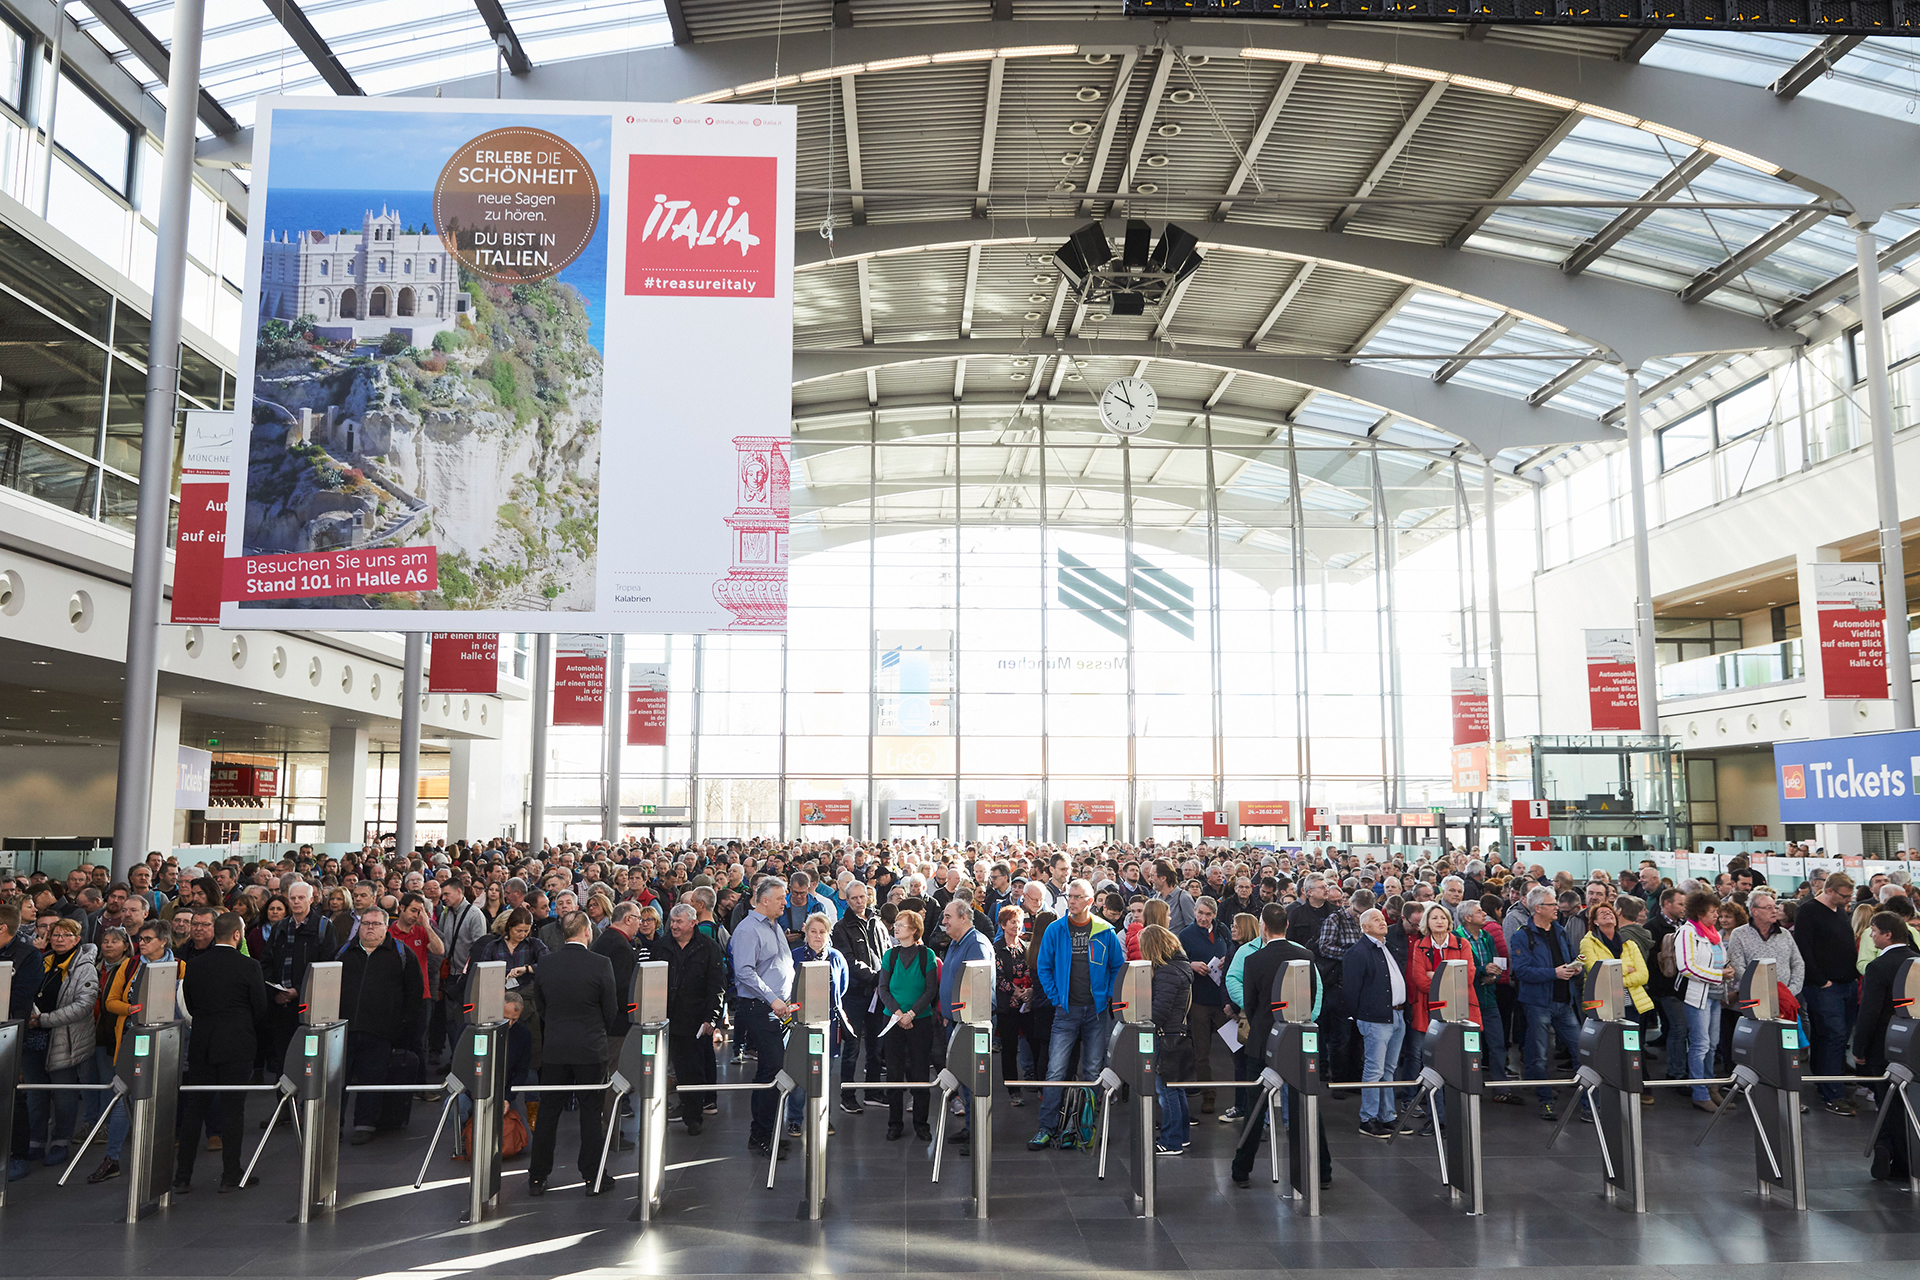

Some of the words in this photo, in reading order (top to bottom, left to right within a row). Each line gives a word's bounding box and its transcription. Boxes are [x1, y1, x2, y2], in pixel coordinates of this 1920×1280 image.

[476, 150, 532, 164] ERLEBE
[537, 152, 562, 166] DIE
[458, 165, 578, 186] SCHÖNHEIT
[478, 194, 511, 206] neue
[515, 192, 556, 209] Sagen
[484, 210, 501, 222] zu
[504, 207, 547, 222] hören.
[474, 232, 498, 246] DU
[502, 232, 536, 246] BIST
[540, 233, 556, 247] IN
[475, 250, 553, 267] ITALIEN.
[644, 276, 757, 293] #treasureitaly
[182, 530, 204, 542] auf
[247, 558, 330, 574] Besuchen
[336, 554, 360, 569] Sie
[366, 555, 396, 565] uns
[401, 552, 428, 564] am
[246, 577, 296, 593] Stand
[300, 574, 331, 590] 101
[336, 574, 351, 588] in
[356, 572, 400, 586] Halle
[404, 569, 428, 584] A6
[615, 584, 641, 592] Tropea
[1833, 620, 1880, 628] Automobile
[1851, 630, 1881, 638] Vielfalt
[471, 642, 480, 650] in
[482, 642, 496, 650] der
[1822, 640, 1835, 648] auf
[1837, 640, 1860, 648] einen
[1862, 640, 1882, 648] Blick
[460, 652, 482, 660] Halle
[485, 652, 496, 660] C4
[1858, 649, 1867, 658] in
[1869, 649, 1883, 658] der
[1850, 659, 1870, 668] Halle
[1872, 660, 1883, 668] C4
[181, 764, 203, 792] Tickets
[1809, 758, 1906, 799] Tickets
